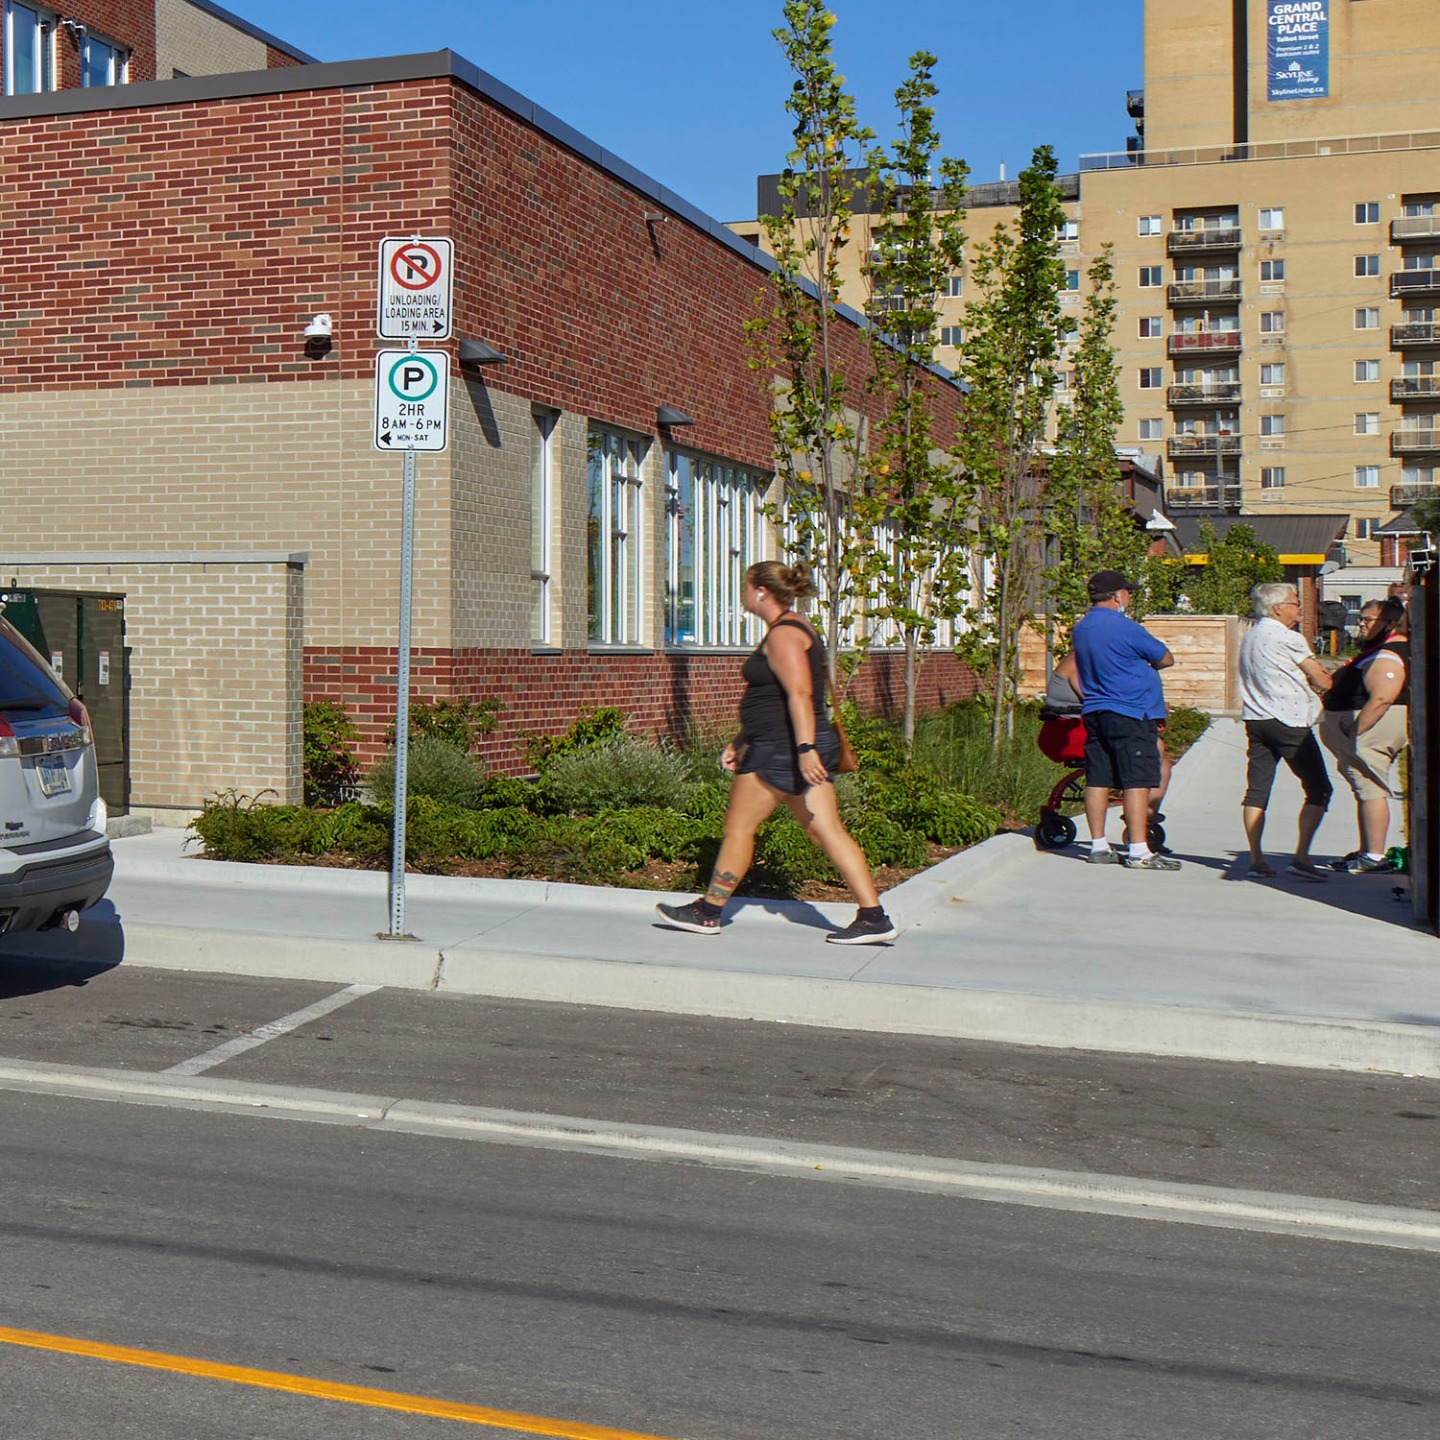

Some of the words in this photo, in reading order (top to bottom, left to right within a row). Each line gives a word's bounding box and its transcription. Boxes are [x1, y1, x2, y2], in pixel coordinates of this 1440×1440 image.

[1273, 1, 1322, 14] GRAND
[1268, 11, 1327, 25] CENTRAL
[1278, 22, 1318, 34] PLACE
[389, 294, 441, 306] UNLOADING/
[385, 307, 421, 318] LOADING
[423, 307, 445, 318] AREA
[401, 320, 410, 331] 15
[412, 320, 429, 331] MIN.
[403, 367, 424, 391] P
[398, 403, 425, 416] 2HR
